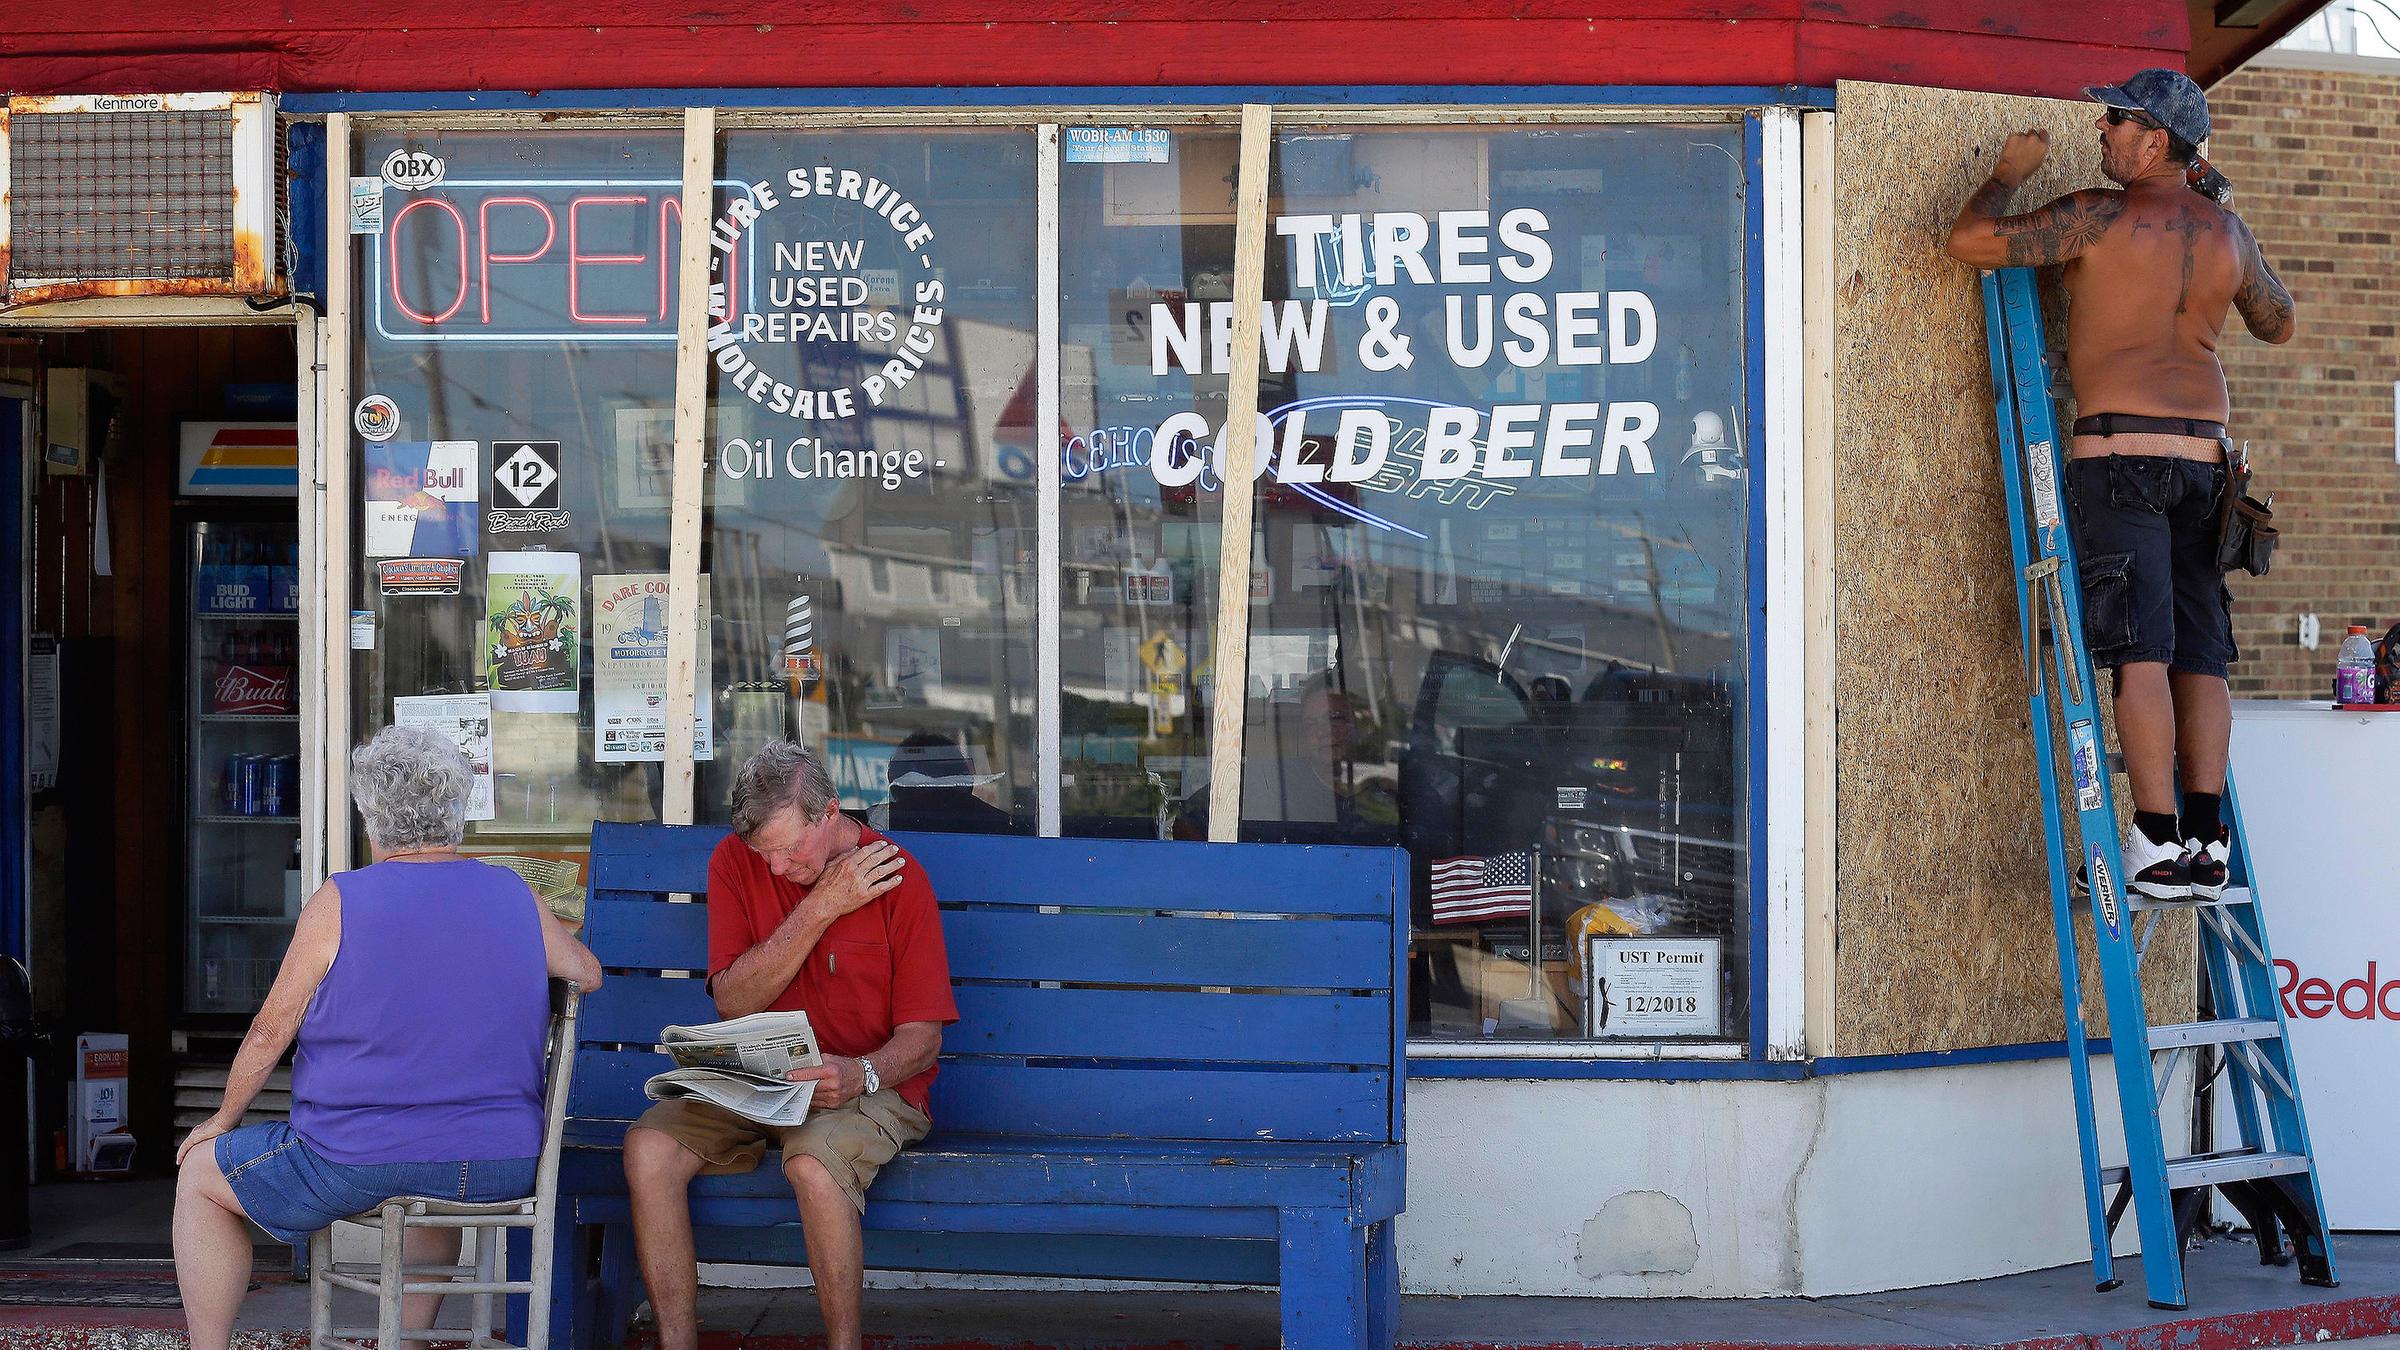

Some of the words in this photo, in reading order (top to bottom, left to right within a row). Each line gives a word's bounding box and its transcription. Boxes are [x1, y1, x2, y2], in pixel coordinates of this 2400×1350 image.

[94, 98, 158, 110] Kenmore
[1070, 129, 1133, 143] WOBR-AM
[1137, 130, 1167, 143] 1530
[393, 160, 435, 177] OBX
[711, 180, 780, 255] TIRE
[786, 166, 935, 252] SERVICE
[774, 240, 865, 272] NEW
[1276, 208, 1554, 287] TIRES
[769, 276, 868, 307] USED
[743, 311, 897, 343] REPAIRS
[1357, 295, 1415, 372] &
[1446, 291, 1658, 368] USED
[708, 282, 856, 420] WHOLESALE
[861, 279, 945, 406] PRICES
[1418, 401, 1661, 481] BEER
[376, 467, 419, 489] Red
[423, 467, 464, 489] Bull
[510, 461, 543, 488] 12
[721, 438, 773, 480] Oil
[785, 437, 924, 491] Change
[490, 513, 535, 531] Beach
[534, 512, 569, 532] Road
[210, 597, 256, 609] LIGHT
[216, 584, 250, 596] BUD
[602, 584, 641, 612] DARE
[614, 648, 660, 656] MOTORCYCLE
[2096, 863, 2115, 922] WERNER
[1620, 951, 1650, 963] UST
[1656, 951, 1704, 964] Permit
[1626, 995, 1697, 1013] 12/2018
